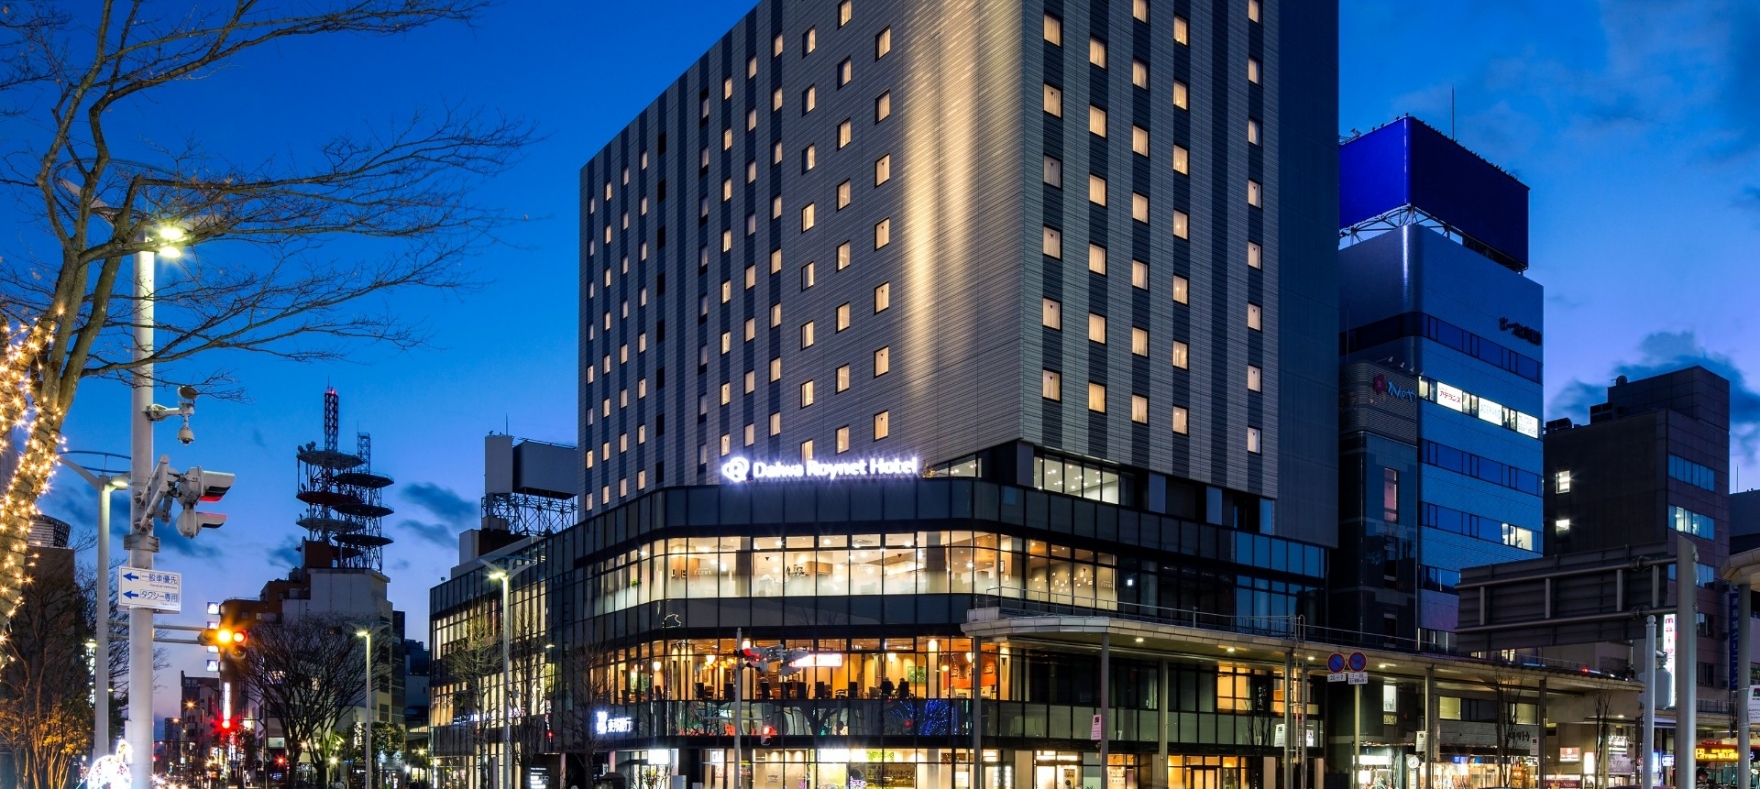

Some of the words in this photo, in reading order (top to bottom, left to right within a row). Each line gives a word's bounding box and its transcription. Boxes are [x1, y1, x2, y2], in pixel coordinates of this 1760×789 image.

[1439, 390, 1461, 404] アデランス
[753, 461, 804, 478] Daiwa
[806, 460, 867, 479] Roynet
[869, 457, 918, 475] Hotel
[141, 573, 178, 585] 一般車優先
[141, 590, 178, 602] タクシー専用
